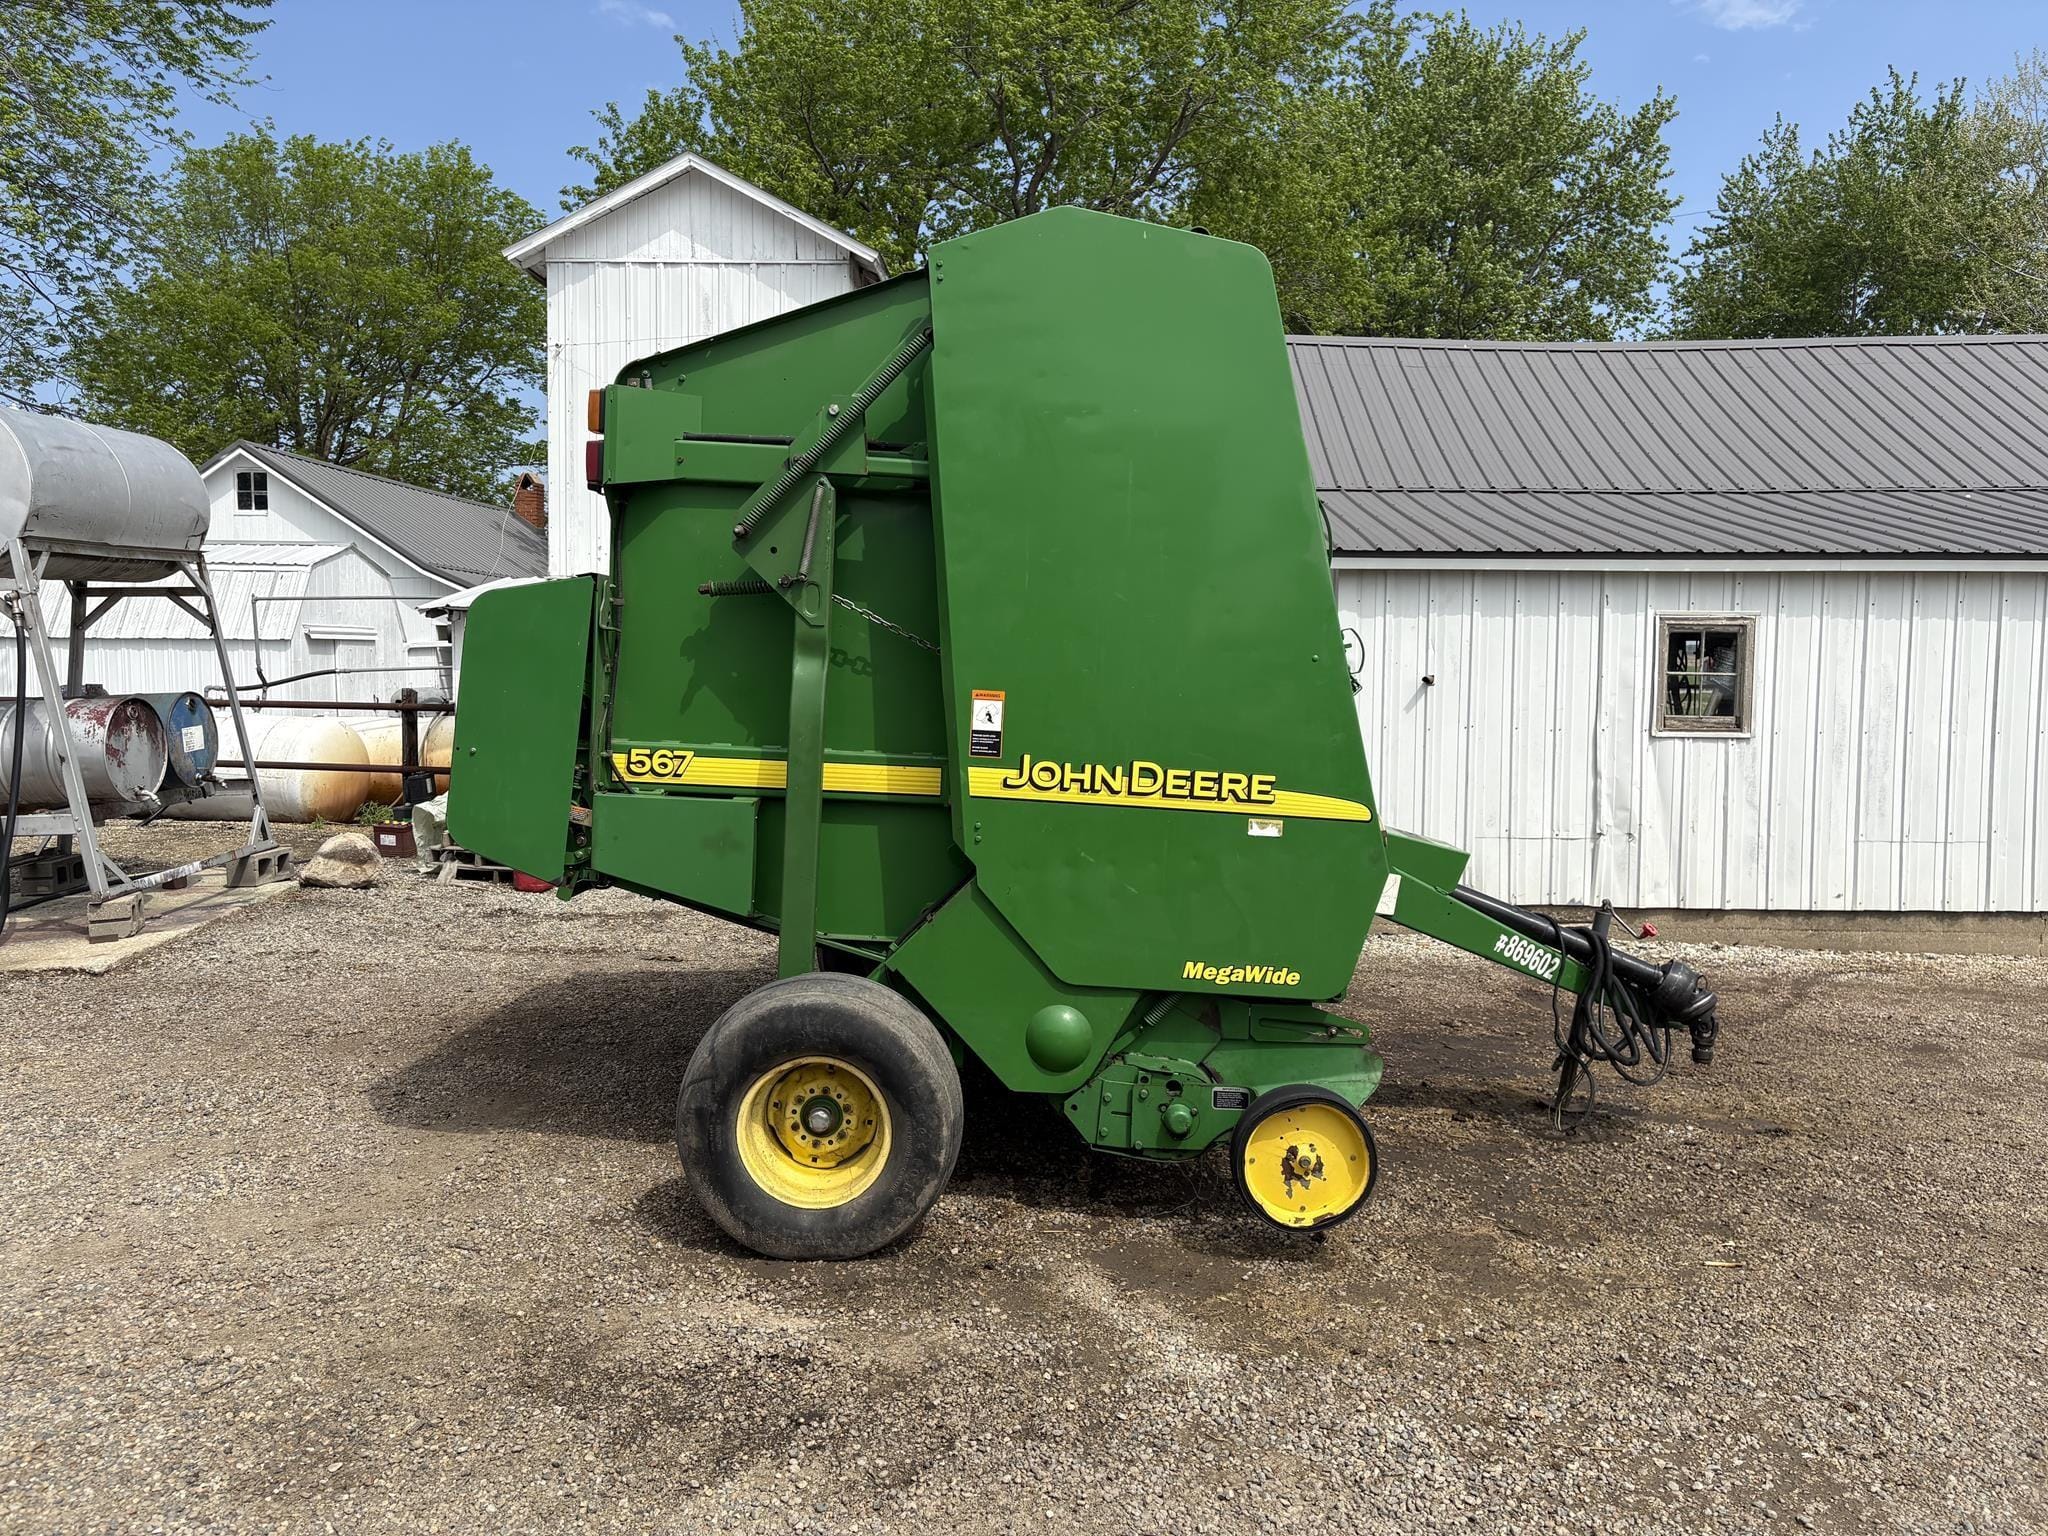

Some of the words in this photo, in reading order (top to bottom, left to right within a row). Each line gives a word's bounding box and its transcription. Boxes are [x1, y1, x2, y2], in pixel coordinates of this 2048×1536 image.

[627, 748, 695, 777] 567
[1003, 753, 1123, 795] JOHN
[1131, 760, 1277, 805] DEERE
[1182, 961, 1301, 986] MegaWide
[1493, 933, 1561, 980] #869602
